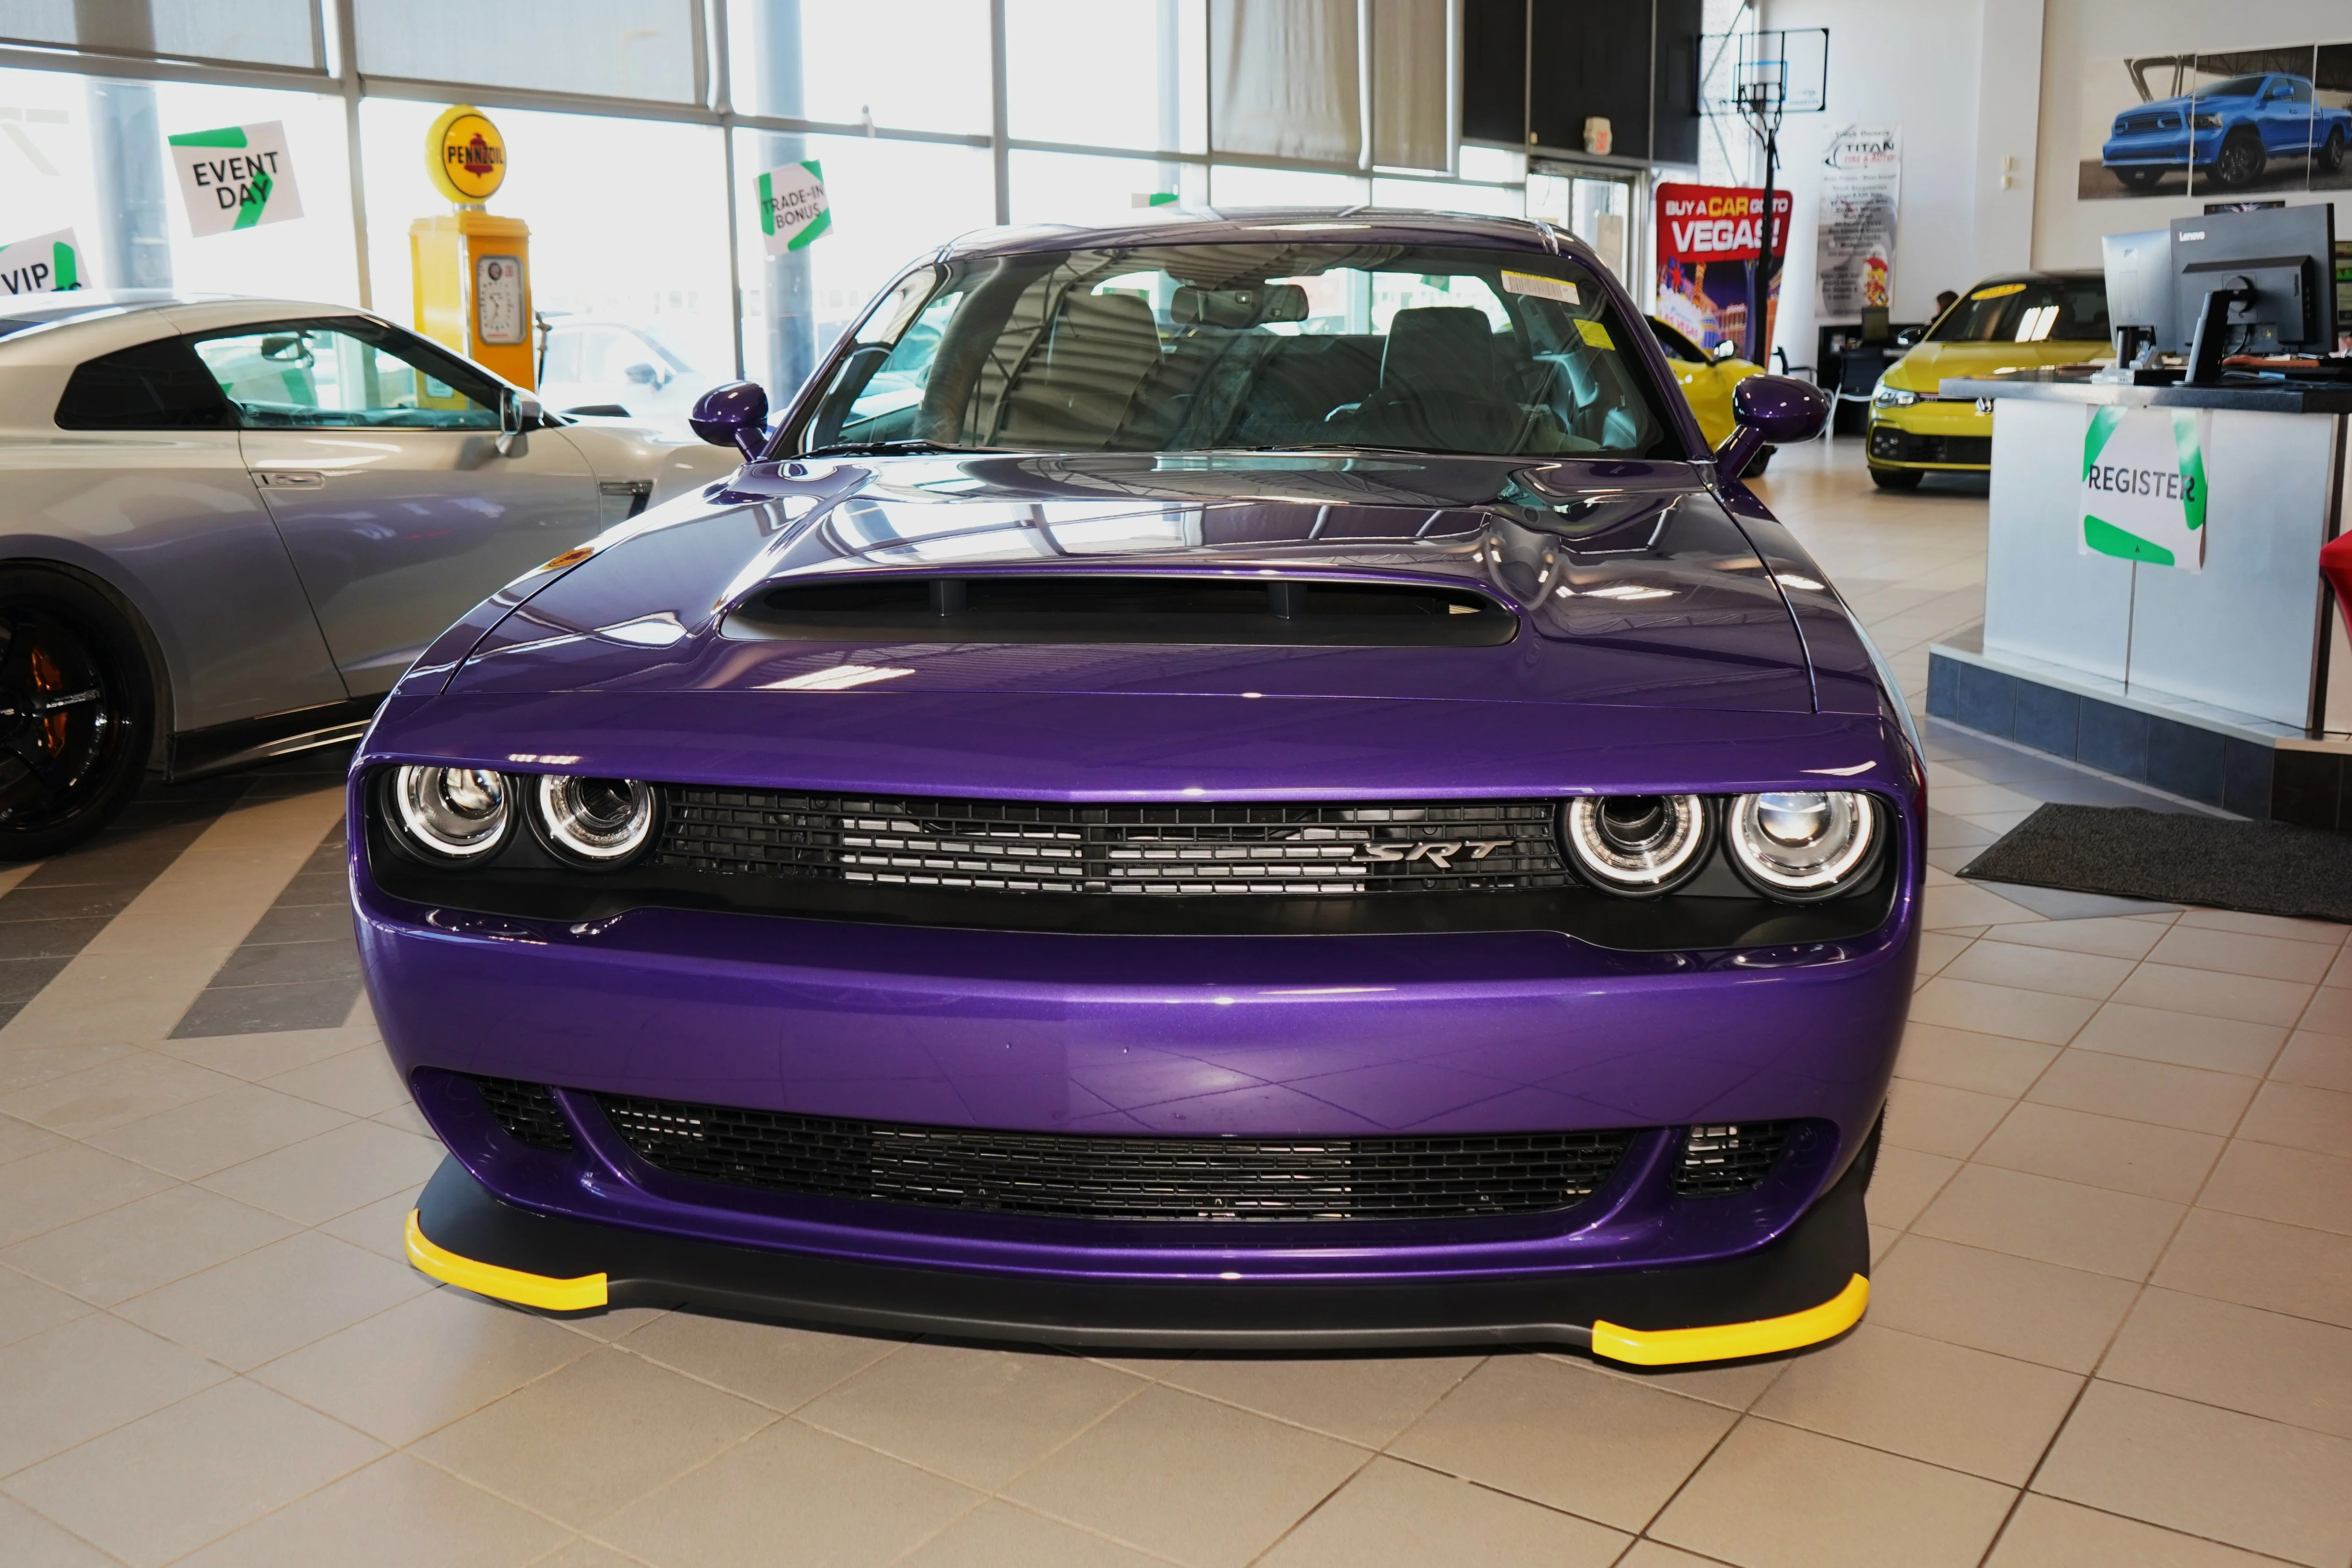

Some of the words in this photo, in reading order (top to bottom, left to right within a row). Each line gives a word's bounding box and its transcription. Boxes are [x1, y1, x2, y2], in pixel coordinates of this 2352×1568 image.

[448, 146, 504, 164] PENNZOIL
[1846, 141, 1894, 152] TITAN
[193, 151, 278, 186] EVENT
[216, 179, 269, 209] DAY
[761, 185, 824, 215] TRADE-IN
[1665, 200, 1695, 216] BUY
[1696, 200, 1707, 215] A
[1708, 196, 1749, 217] CAR
[776, 203, 821, 228] BONUS
[2179, 231, 2206, 242] Lenovo
[1, 263, 49, 295] VIP
[2088, 464, 2195, 503] REGISTER
[1351, 840, 1515, 868] SRT
